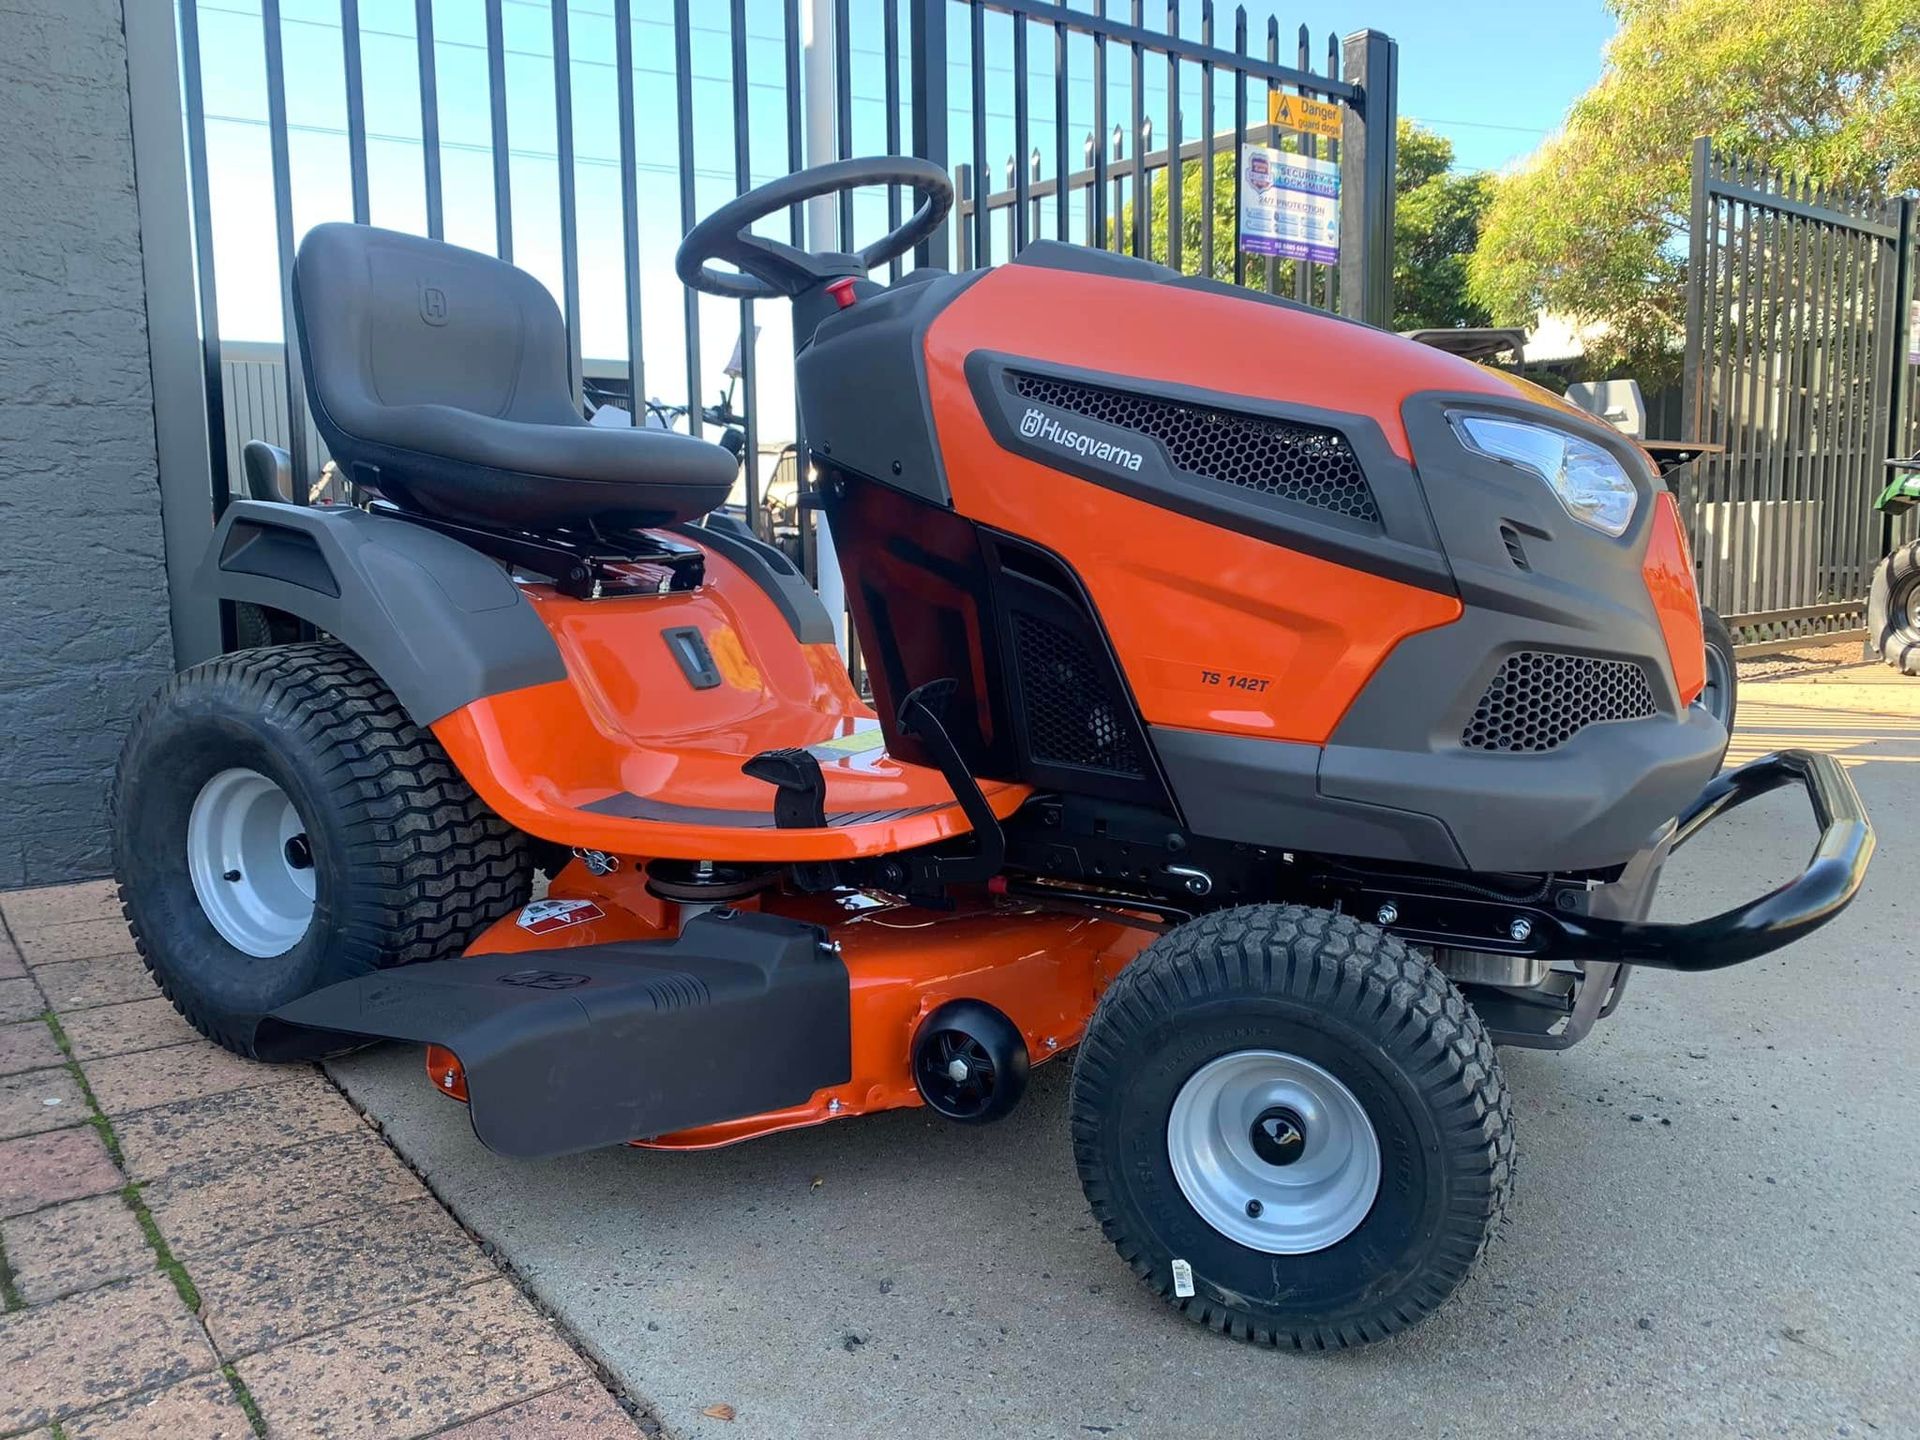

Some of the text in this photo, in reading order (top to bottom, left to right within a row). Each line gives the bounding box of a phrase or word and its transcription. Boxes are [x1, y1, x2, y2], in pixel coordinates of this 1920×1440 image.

[1301, 100, 1337, 120] Danger
[1298, 118, 1340, 136] guard dogs
[1281, 166, 1325, 182] SECURITY
[1278, 176, 1336, 194] LOCKSMITHS
[1258, 196, 1275, 205] 24/7
[1276, 198, 1325, 215] PROTECTION
[1040, 418, 1143, 472] Husqvarna
[1201, 671, 1270, 692] TS 142T
